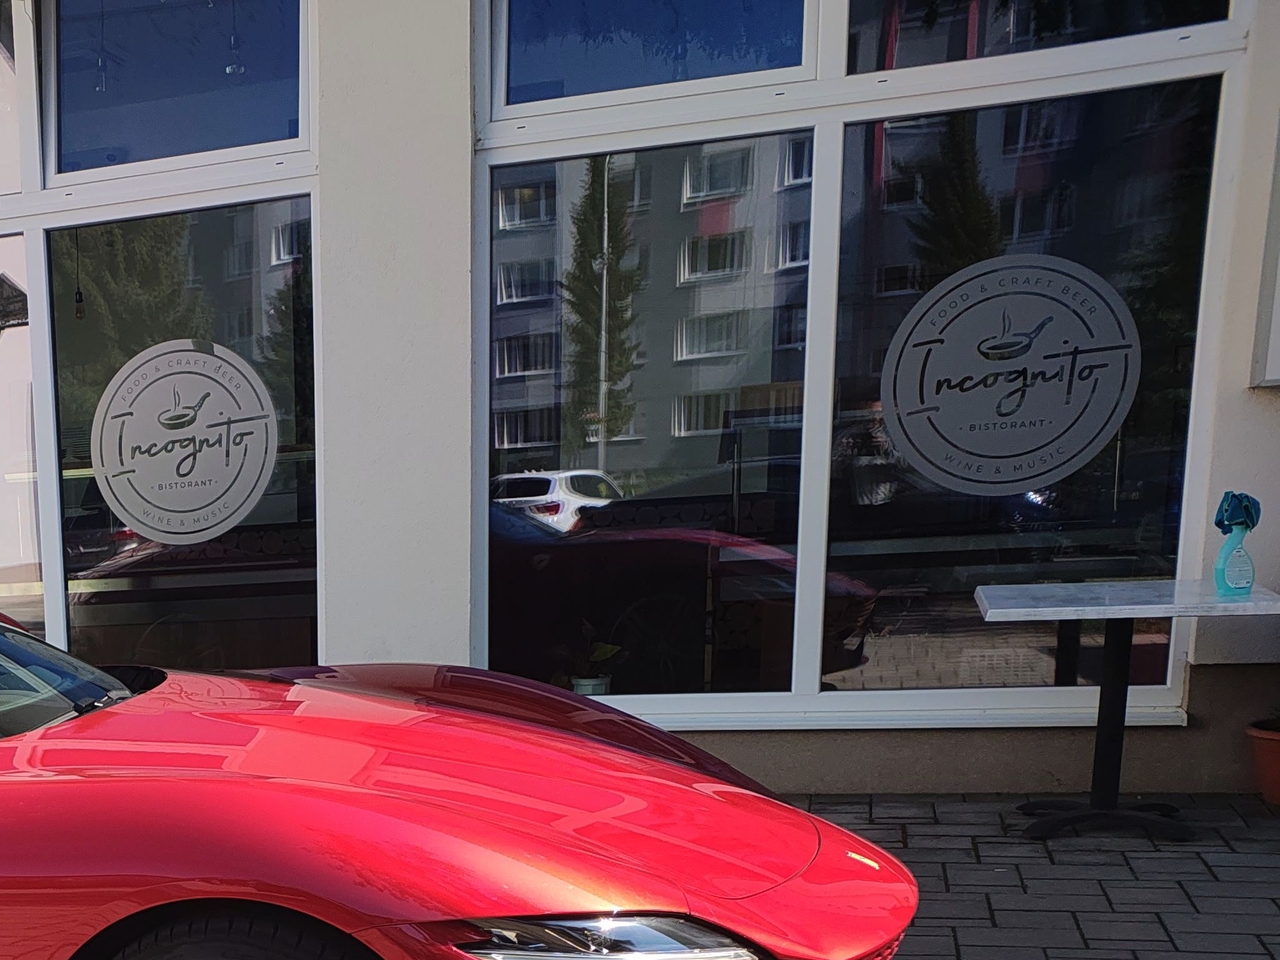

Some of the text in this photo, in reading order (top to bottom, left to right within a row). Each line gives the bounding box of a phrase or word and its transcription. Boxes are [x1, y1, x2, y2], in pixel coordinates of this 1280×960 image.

[930, 276, 1098, 327] FOOD & CRAFT BEER
[121, 358, 242, 402] FOOD & CRAFT BEER
[906, 338, 1133, 418] Incognito
[969, 419, 1046, 432] BISTORANT
[111, 411, 270, 478] Incognito
[943, 445, 1066, 475] WINE & MUSIC
[158, 478, 213, 491] BISTORANT
[141, 501, 230, 527] WINE & MUSIC
